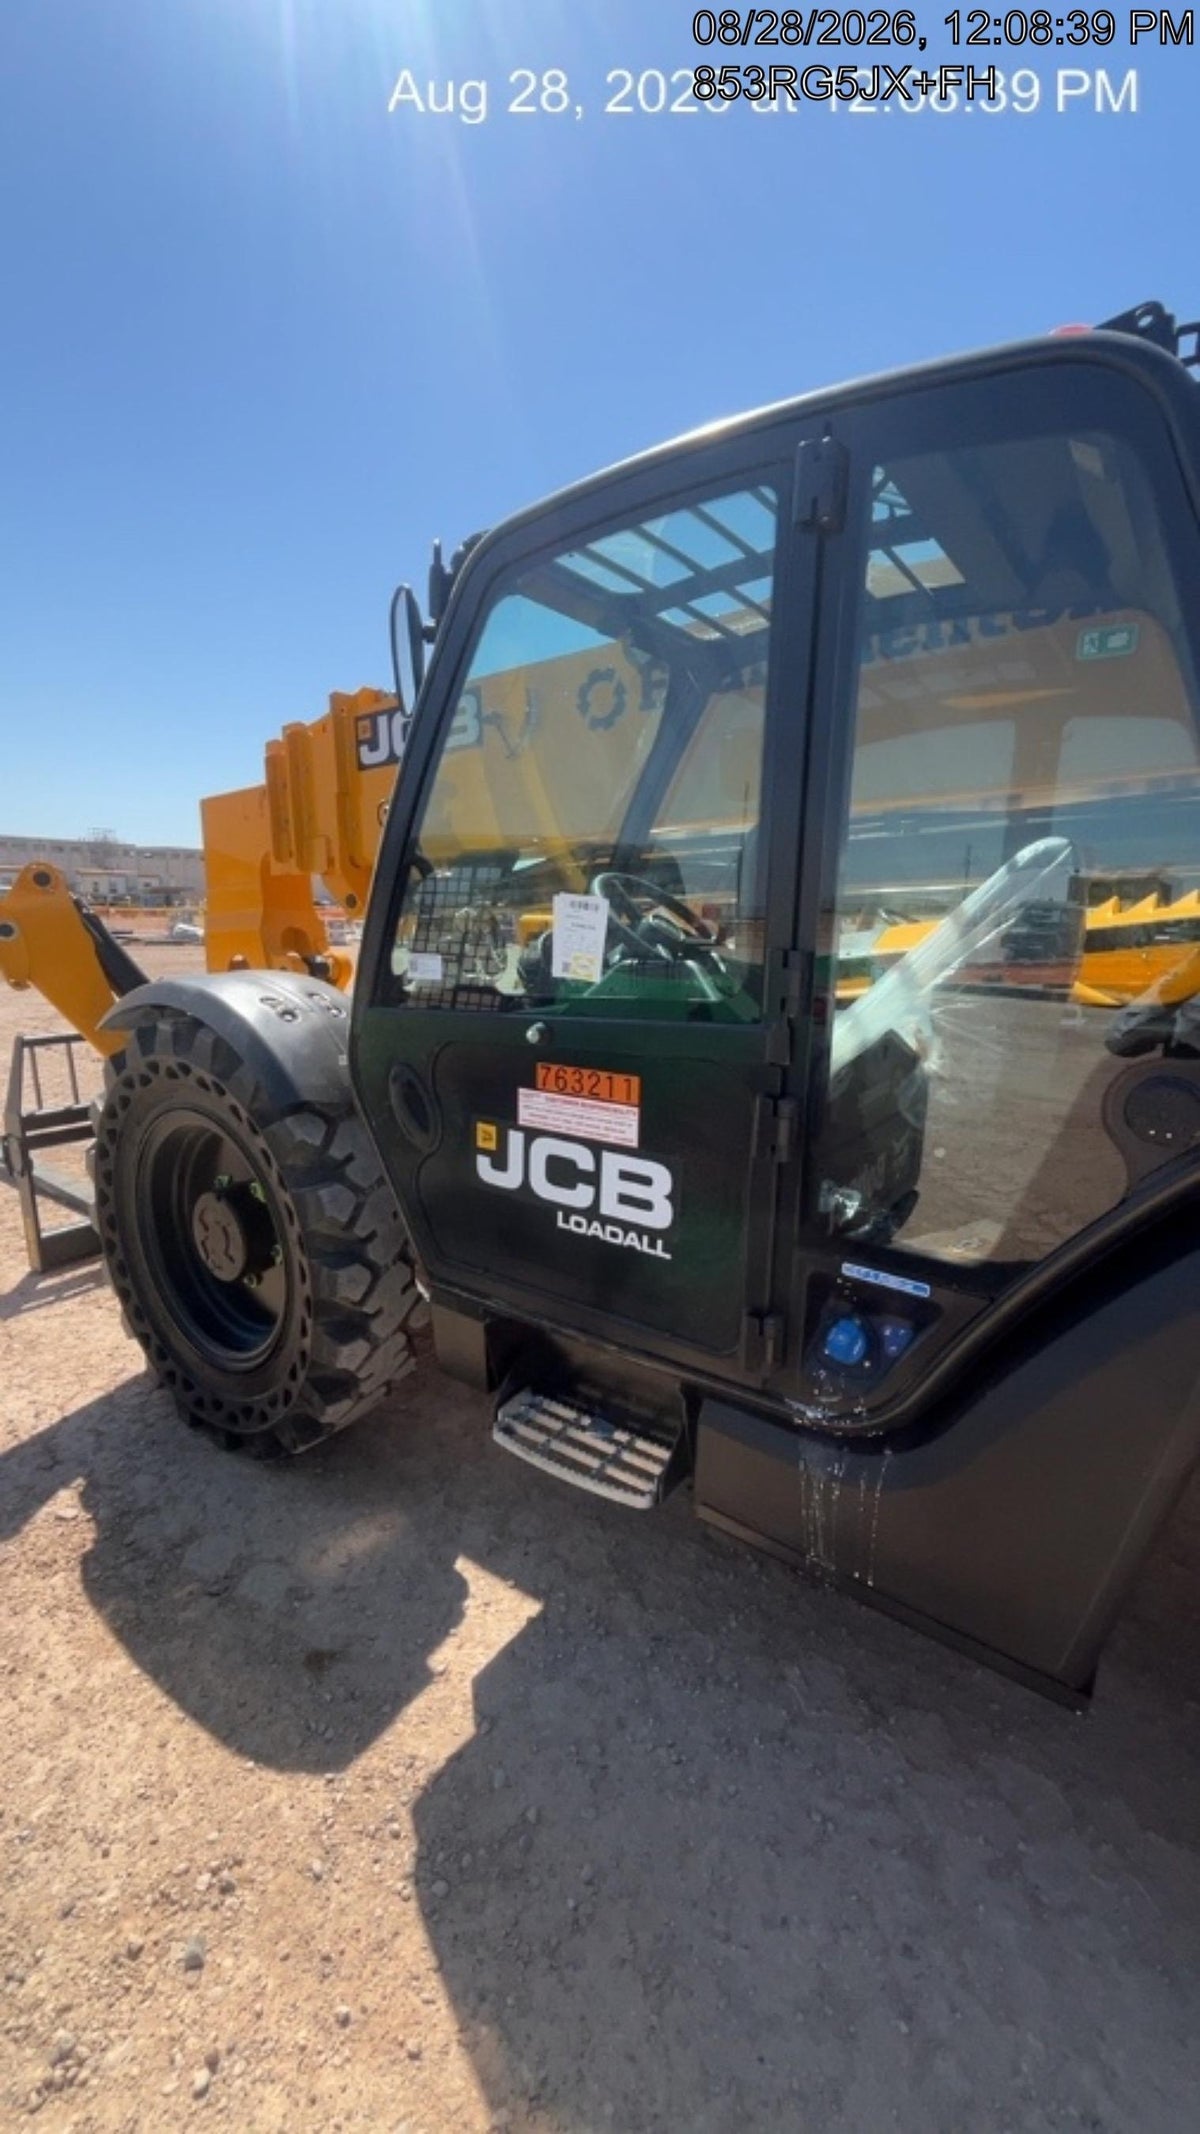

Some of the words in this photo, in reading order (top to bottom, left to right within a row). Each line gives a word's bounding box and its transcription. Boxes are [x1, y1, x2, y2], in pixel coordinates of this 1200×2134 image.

[540, 1064, 632, 1101] 763211
[476, 1128, 674, 1229] JCB
[556, 1211, 672, 1260] LOADALL
